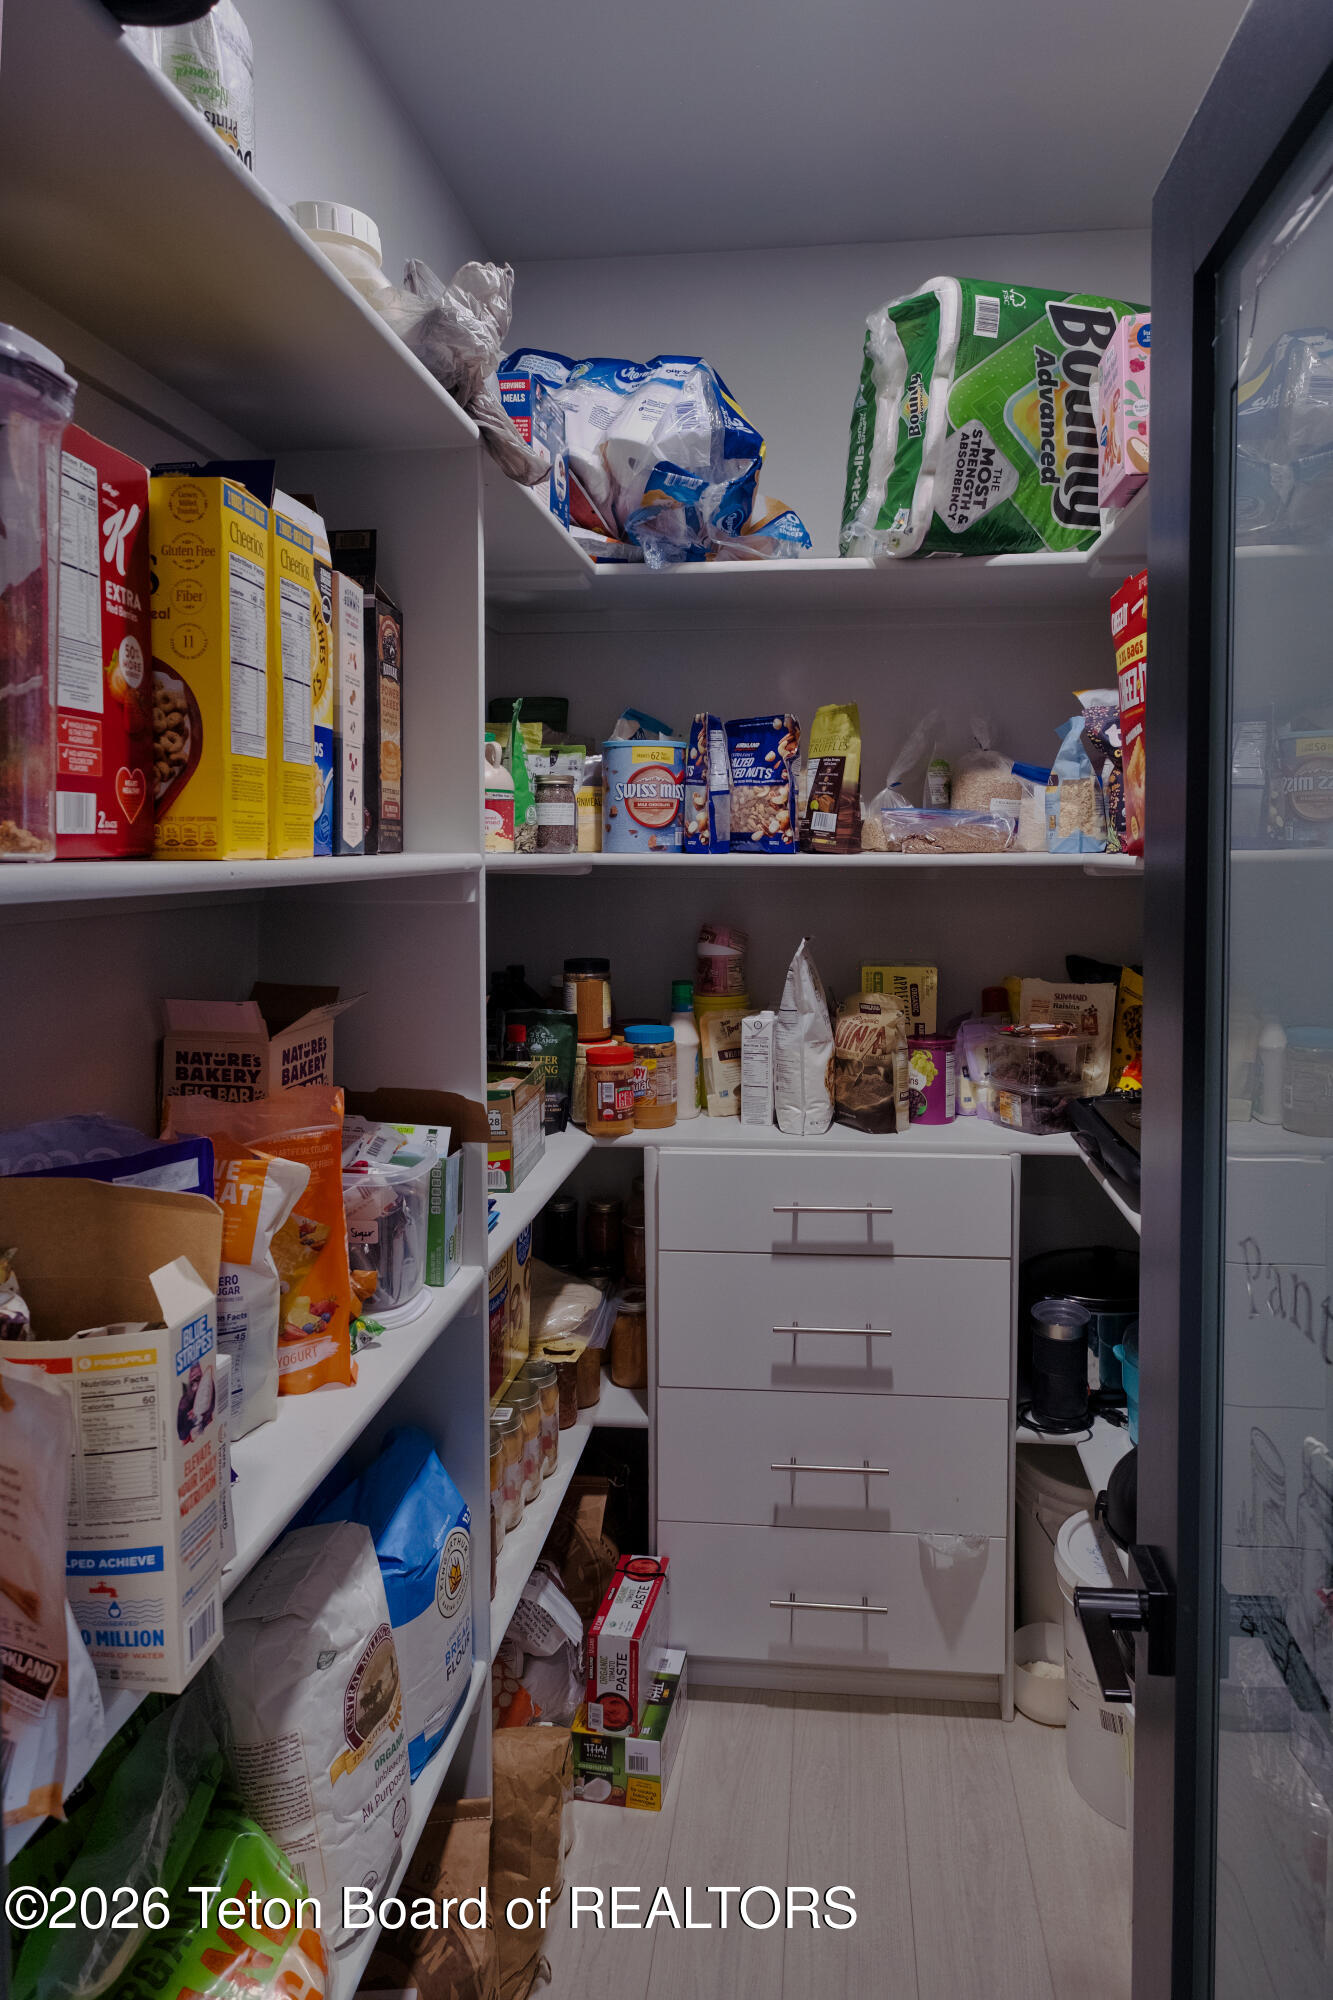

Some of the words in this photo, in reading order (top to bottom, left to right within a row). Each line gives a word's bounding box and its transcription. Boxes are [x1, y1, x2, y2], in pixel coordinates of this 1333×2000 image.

[502, 393, 526, 403] MEALS
[907, 372, 923, 438] Bounty
[1033, 345, 1061, 487] Advanced
[947, 432, 970, 521] ABSORBENCY
[959, 429, 982, 512] STRENGTH
[972, 448, 995, 510] MOST
[991, 468, 1003, 493] THE
[957, 513, 968, 524] &
[103, 503, 142, 578] K
[161, 543, 194, 557] Gluten
[196, 544, 216, 558] Free
[229, 520, 265, 561] Cheerios
[280, 548, 310, 582] Cheerios
[105, 580, 142, 612] EXTRA
[175, 589, 203, 603] Fiber
[183, 634, 194, 649] 11
[650, 751, 660, 760] 62
[747, 767, 774, 780] NUTS
[1053, 1002, 1081, 1011] Raisins
[175, 1067, 262, 1084] BAKERY
[281, 1052, 328, 1086] BAKERY
[217, 1086, 250, 1103] BAR
[488, 1118, 501, 1126] 28
[350, 1227, 374, 1241] Sugar
[218, 1274, 239, 1287] ERO
[226, 1312, 248, 1321] Facts
[182, 1314, 208, 1350] BLUE
[93, 1353, 152, 1368] PINEAPPLE
[176, 1329, 213, 1375] STRIPES
[278, 1346, 318, 1367] YOGURT
[80, 1378, 121, 1389] Nutrition
[123, 1375, 149, 1385] Facts
[81, 1402, 115, 1412] Calories
[142, 1396, 156, 1406] 60
[98, 1553, 156, 1569] ACHIEVE
[631, 1585, 650, 1610] PASTE
[96, 1630, 164, 1647] MILLION
[445, 1616, 471, 1666] BREAD
[446, 1631, 471, 1682] FLOUR
[599, 1655, 609, 1685] ORGANIC
[608, 1659, 616, 1684] TOMATO
[616, 1652, 628, 1692] PASTE
[583, 1742, 608, 1754] THAI
[361, 1800, 375, 1823] All
